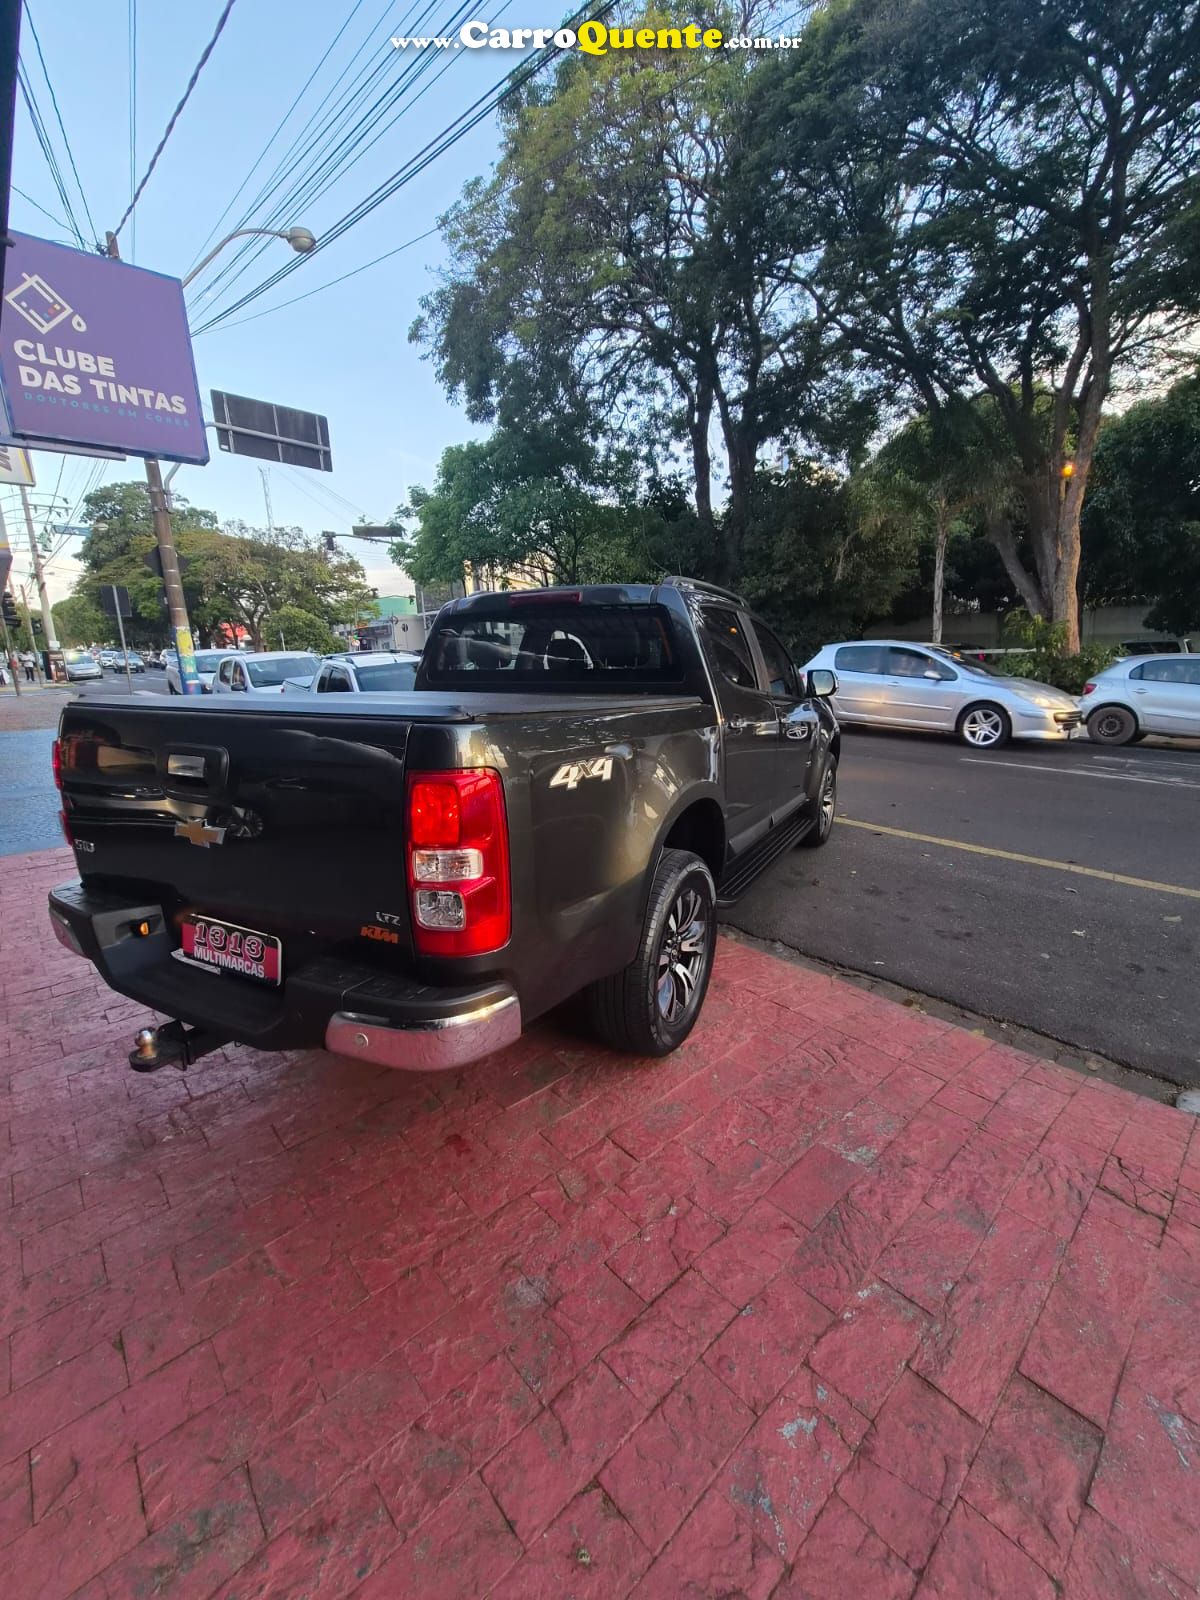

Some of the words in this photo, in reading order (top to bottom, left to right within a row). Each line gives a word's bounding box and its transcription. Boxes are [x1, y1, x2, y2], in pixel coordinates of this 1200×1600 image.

[13, 339, 116, 378] CLUBE
[18, 365, 82, 395] DAS
[89, 378, 187, 415] TINTAS
[23, 391, 110, 414] DOUTORES
[118, 407, 137, 419] EM
[145, 412, 191, 428] CORES
[360, 925, 399, 944] KTM
[375, 911, 401, 926] LTZ
[193, 921, 266, 964] 1313
[193, 945, 265, 978] MULTIMARCAS
